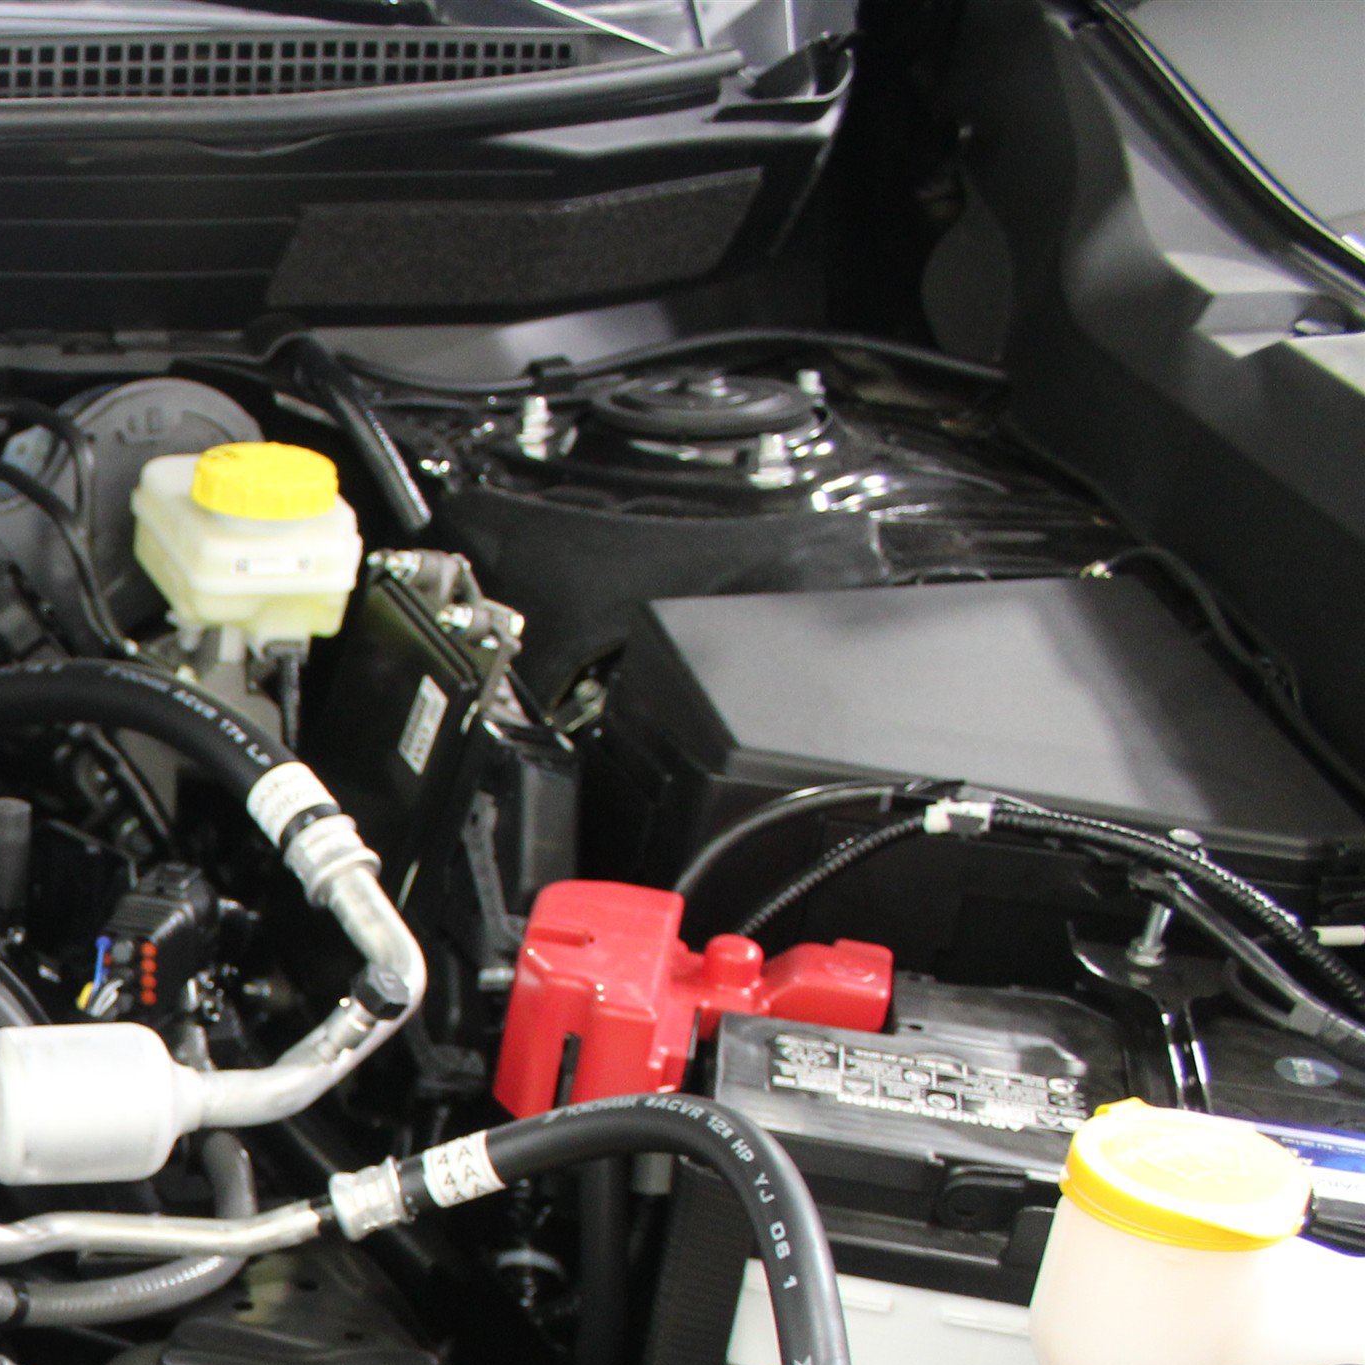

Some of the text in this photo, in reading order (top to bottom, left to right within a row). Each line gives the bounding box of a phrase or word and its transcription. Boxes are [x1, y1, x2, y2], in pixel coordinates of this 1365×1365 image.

[655, 1098, 705, 1121] ACVR
[729, 1138, 756, 1164] HP
[753, 1171, 776, 1204] YJ
[782, 1274, 799, 1291] 1
